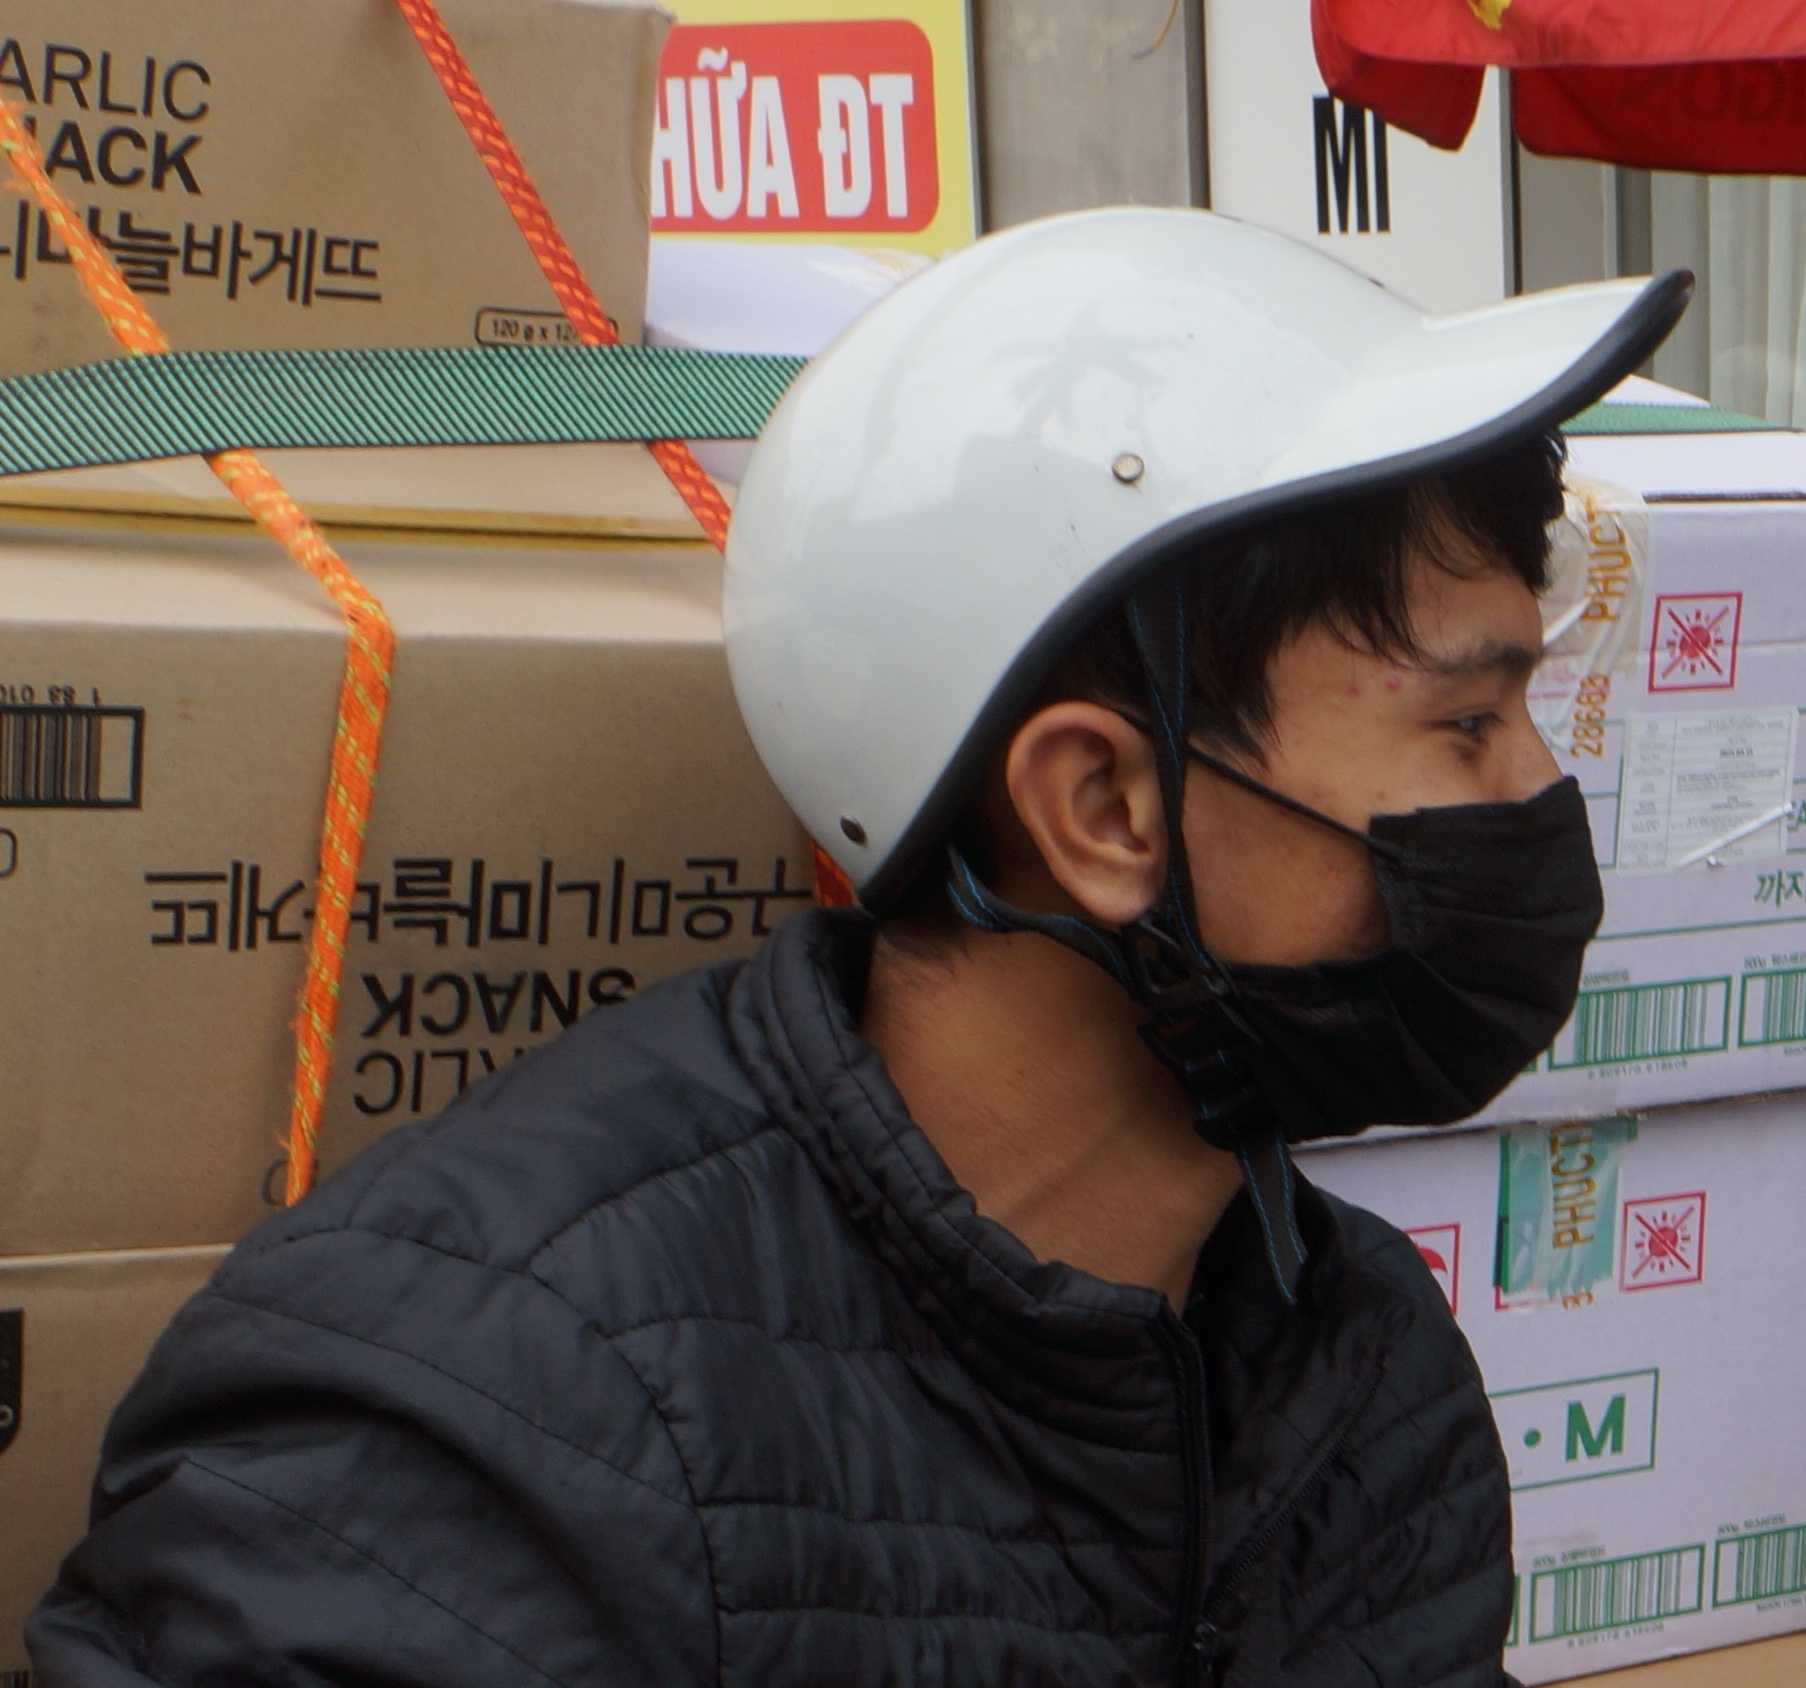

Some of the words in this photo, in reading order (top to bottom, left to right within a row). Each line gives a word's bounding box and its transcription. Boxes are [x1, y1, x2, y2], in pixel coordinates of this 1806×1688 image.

[24, 115, 203, 196] ACK
[817, 73, 914, 219] ĐT
[1565, 1394, 1626, 1462] M
